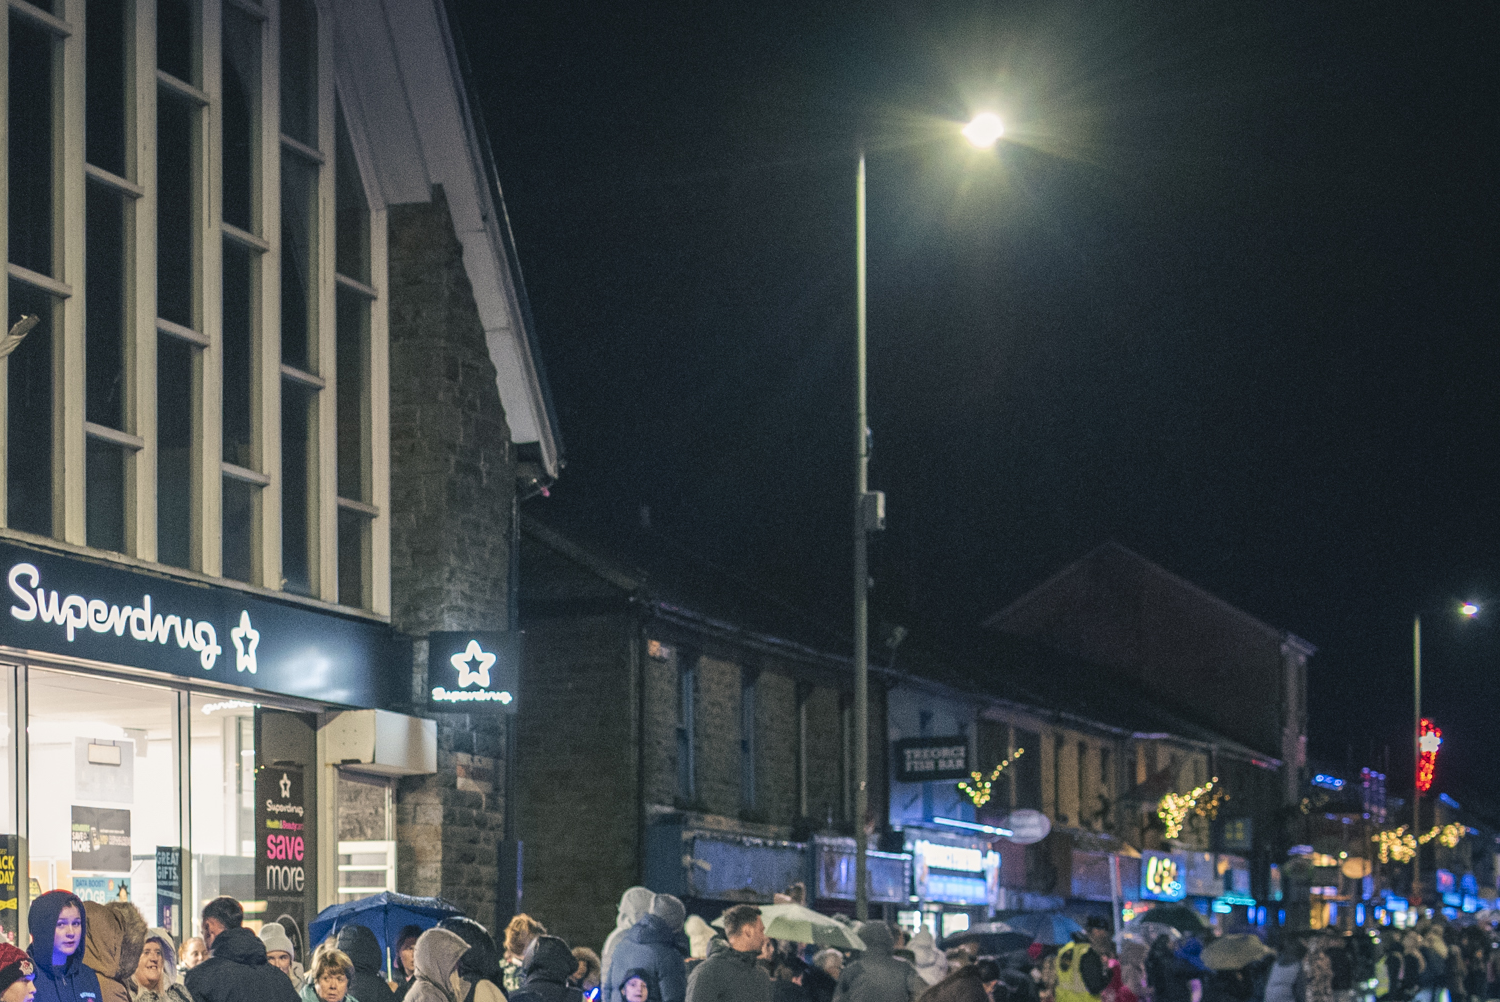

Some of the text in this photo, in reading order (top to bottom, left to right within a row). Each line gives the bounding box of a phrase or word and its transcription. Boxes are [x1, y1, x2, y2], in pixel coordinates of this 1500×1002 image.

[8, 562, 222, 671] Superdrug
[431, 686, 513, 705] Superdrug
[266, 799, 304, 817] Superdrug
[72, 840, 90, 853] MORE
[267, 834, 304, 861] save
[157, 851, 179, 866] GREAT
[76, 879, 87, 887] DATA
[266, 865, 305, 892] more
